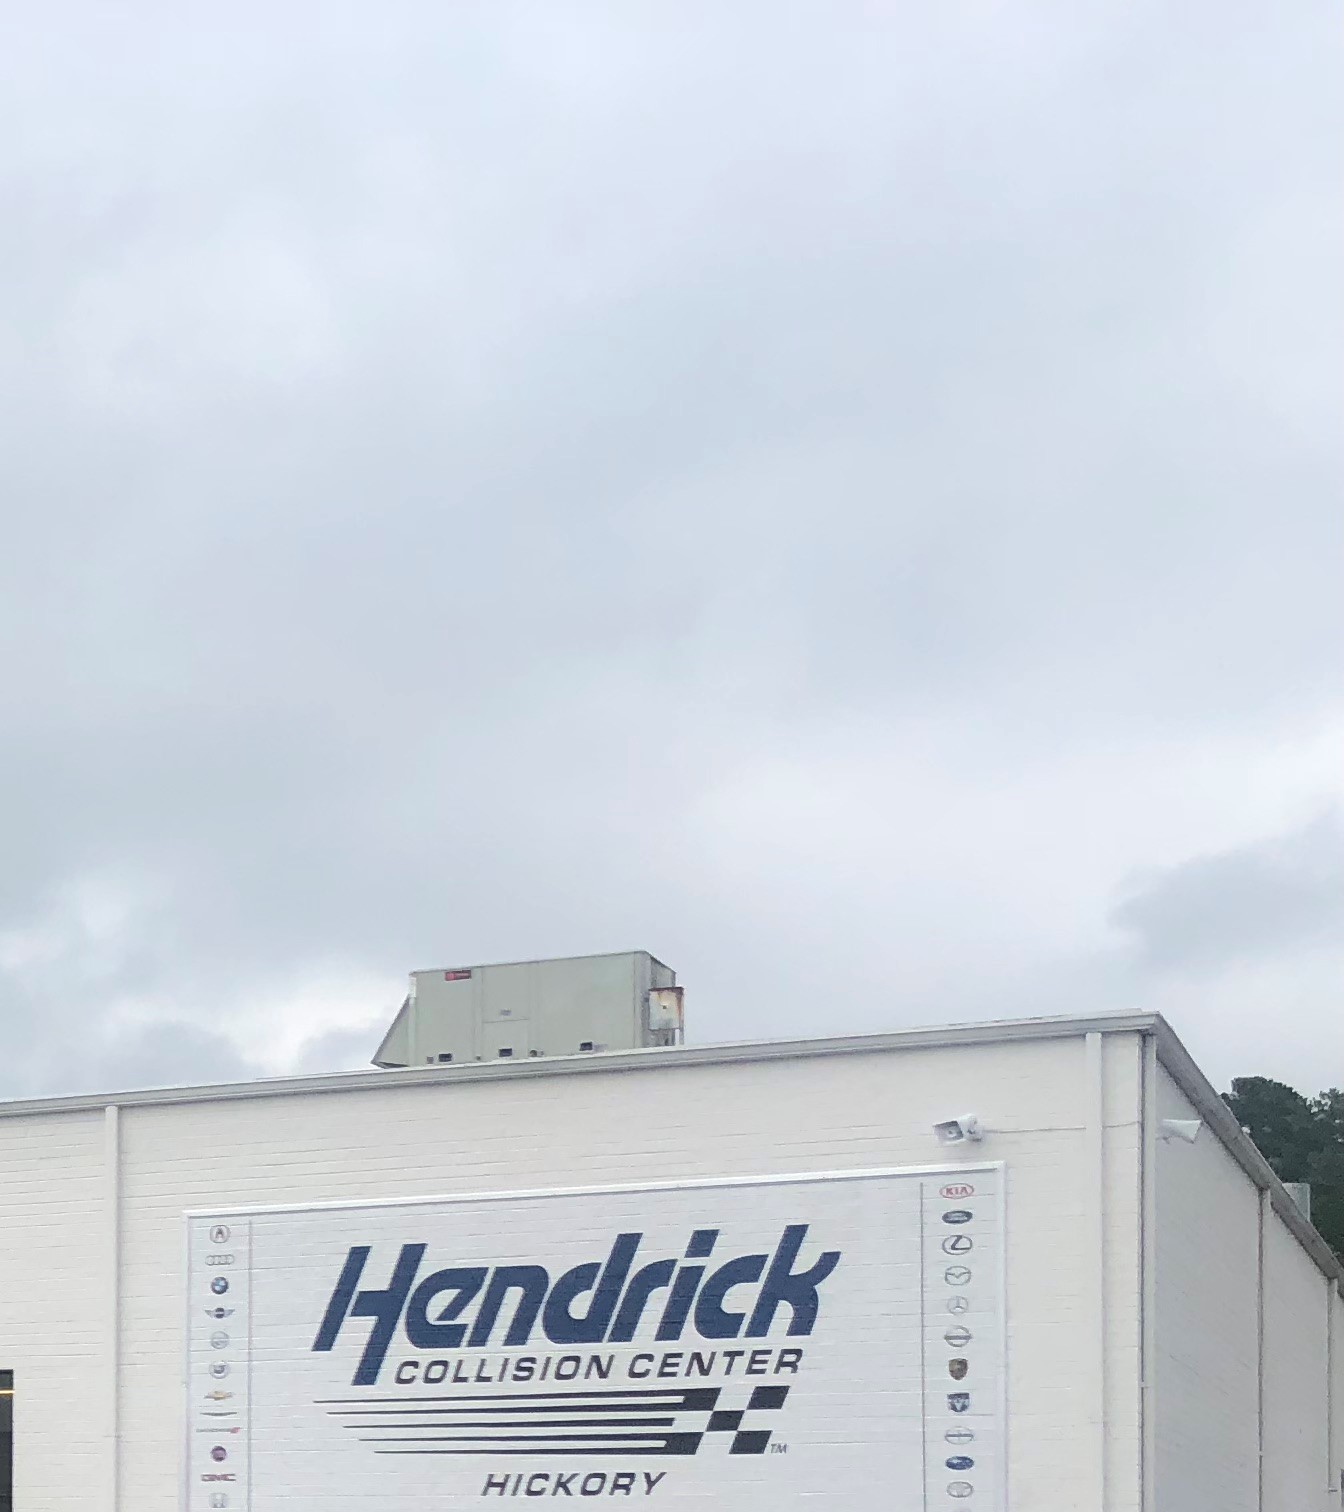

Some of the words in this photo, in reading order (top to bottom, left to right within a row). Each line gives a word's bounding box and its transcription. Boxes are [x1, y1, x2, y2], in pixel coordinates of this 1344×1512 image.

[311, 1224, 841, 1385] Hendrick
[394, 1354, 615, 1385] COLLISION
[627, 1347, 804, 1379] CENTER
[770, 1443, 787, 1454] TM
[480, 1471, 667, 1497] HICKORY
